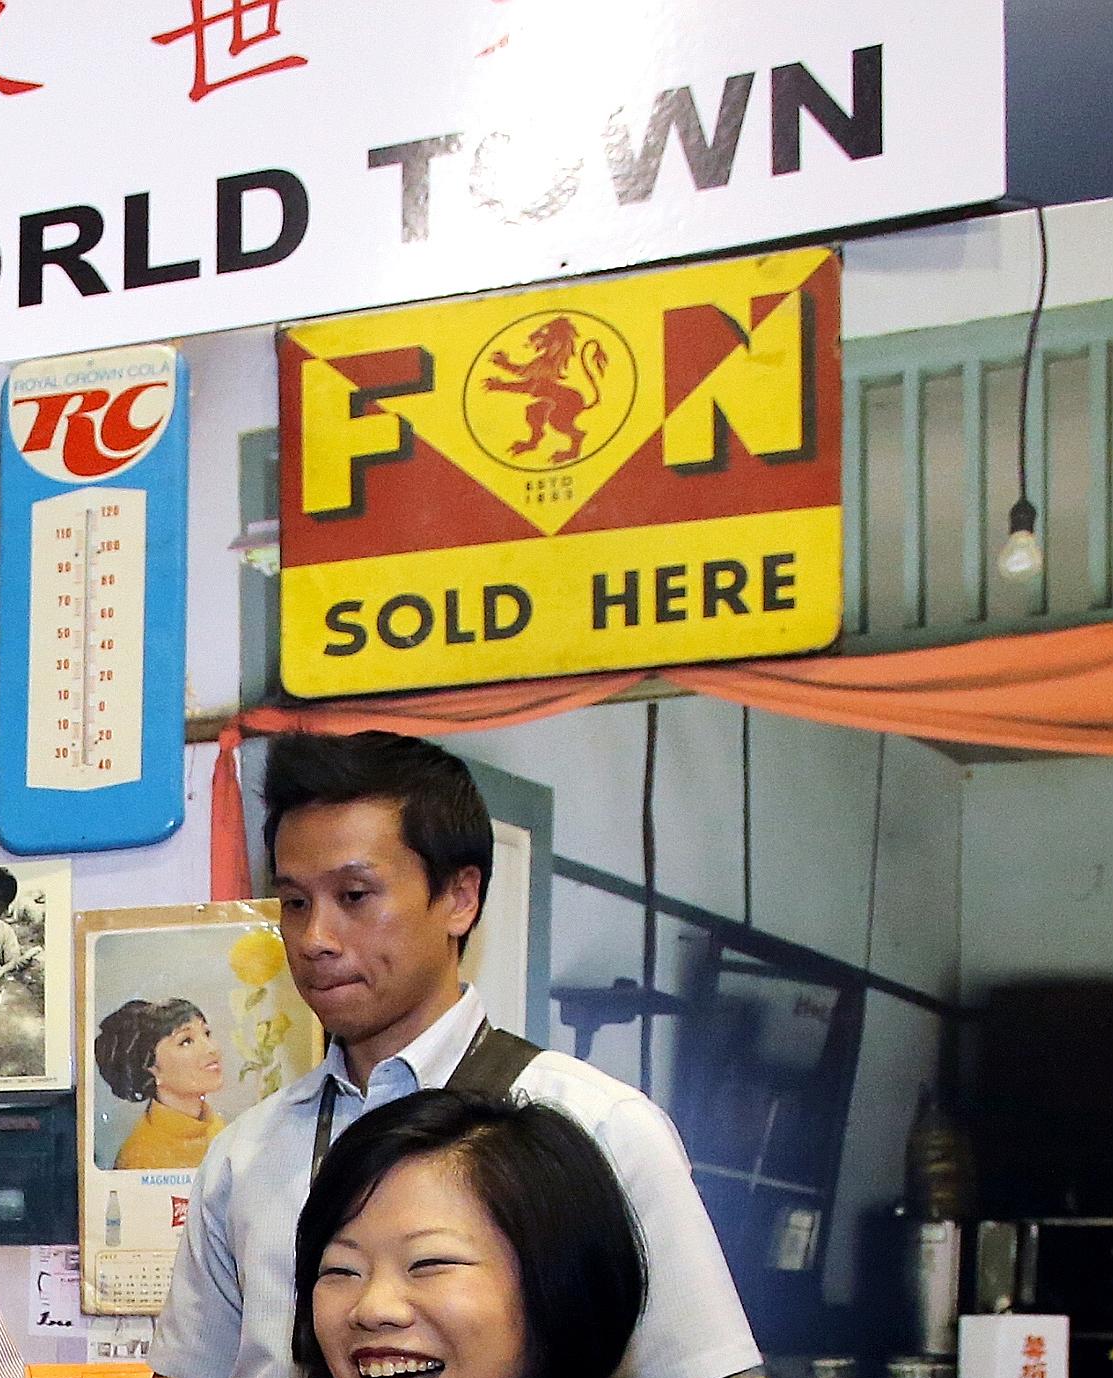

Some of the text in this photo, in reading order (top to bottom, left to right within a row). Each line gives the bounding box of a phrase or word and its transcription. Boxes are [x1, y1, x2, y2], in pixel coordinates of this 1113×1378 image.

[368, 44, 885, 244] TOWN
[14, 359, 171, 393] ROYAL CROWN COLA
[13, 381, 169, 477] RC
[56, 528, 72, 539] 110
[57, 561, 72, 573] 90
[58, 595, 71, 607] 70
[323, 552, 798, 657] SOLD HERE
[57, 627, 71, 639] 50
[100, 639, 114, 650] 40
[56, 659, 70, 671] 30
[57, 689, 70, 701] 10
[57, 719, 69, 730] 10
[55, 747, 69, 759] 30
[98, 758, 112, 770] 40
[141, 1174, 192, 1185] MAGNOLIA
